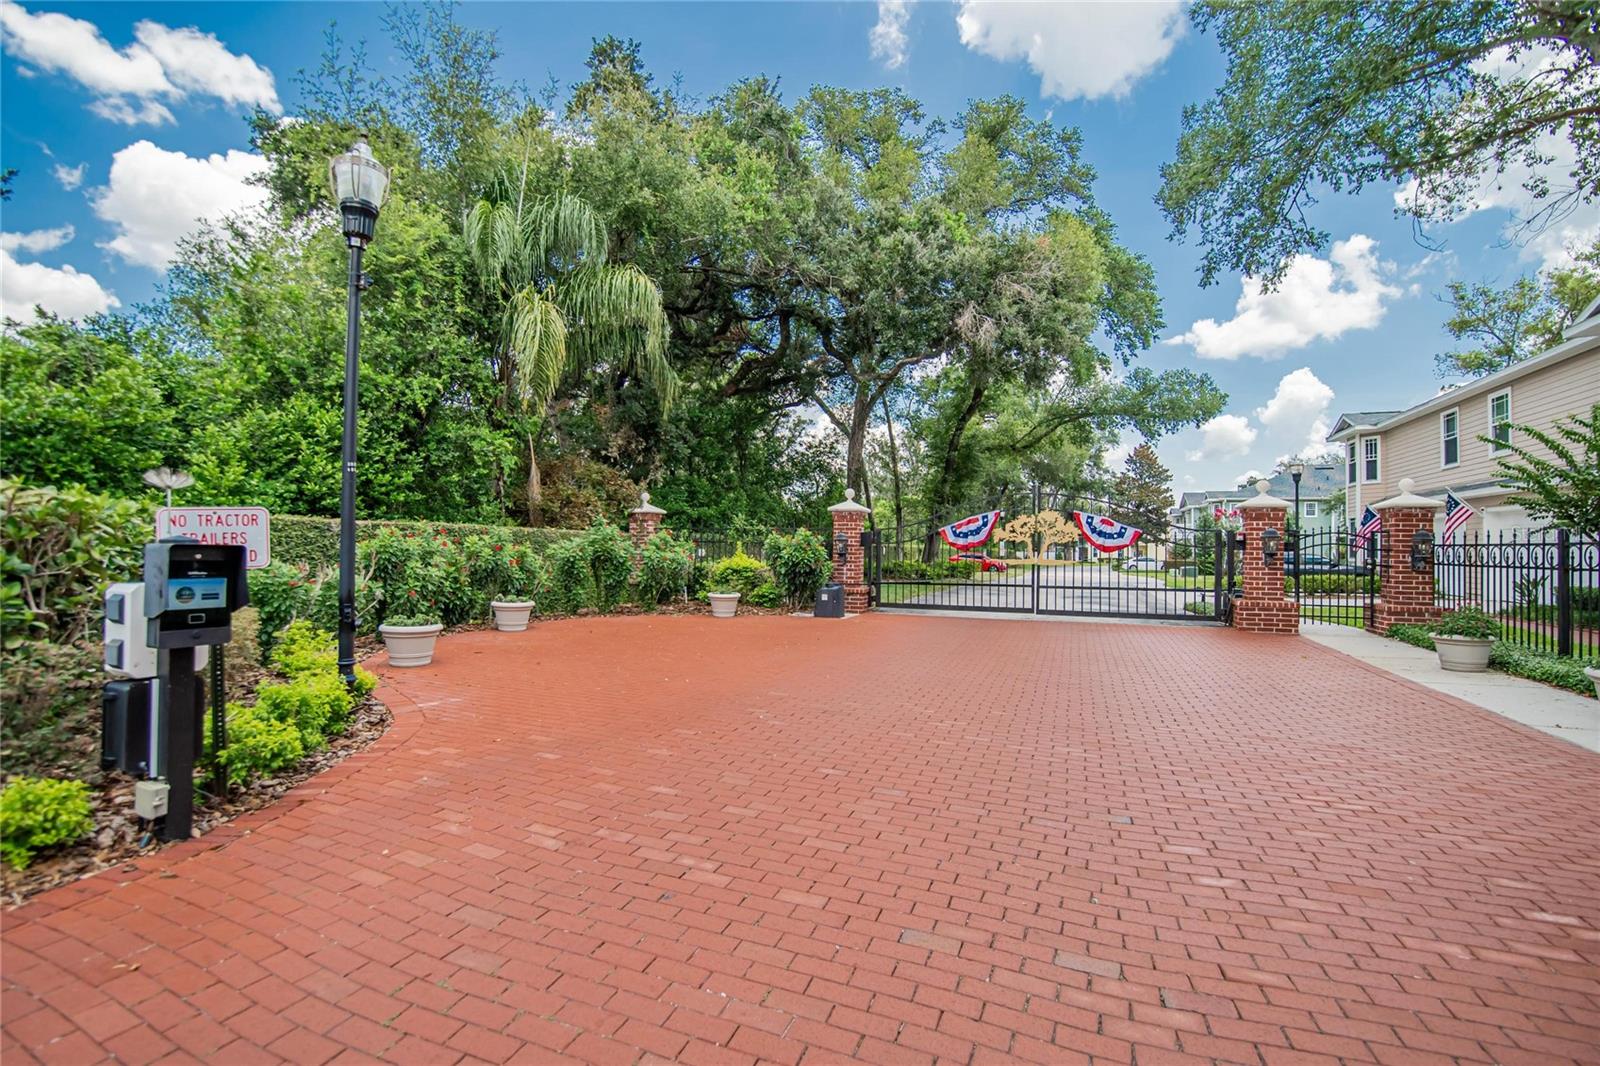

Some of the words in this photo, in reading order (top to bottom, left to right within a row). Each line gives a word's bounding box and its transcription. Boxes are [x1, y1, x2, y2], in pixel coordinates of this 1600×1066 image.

[170, 515, 187, 527] NO
[197, 514, 258, 527] TRACTOR
[182, 532, 247, 545] RAILERS
